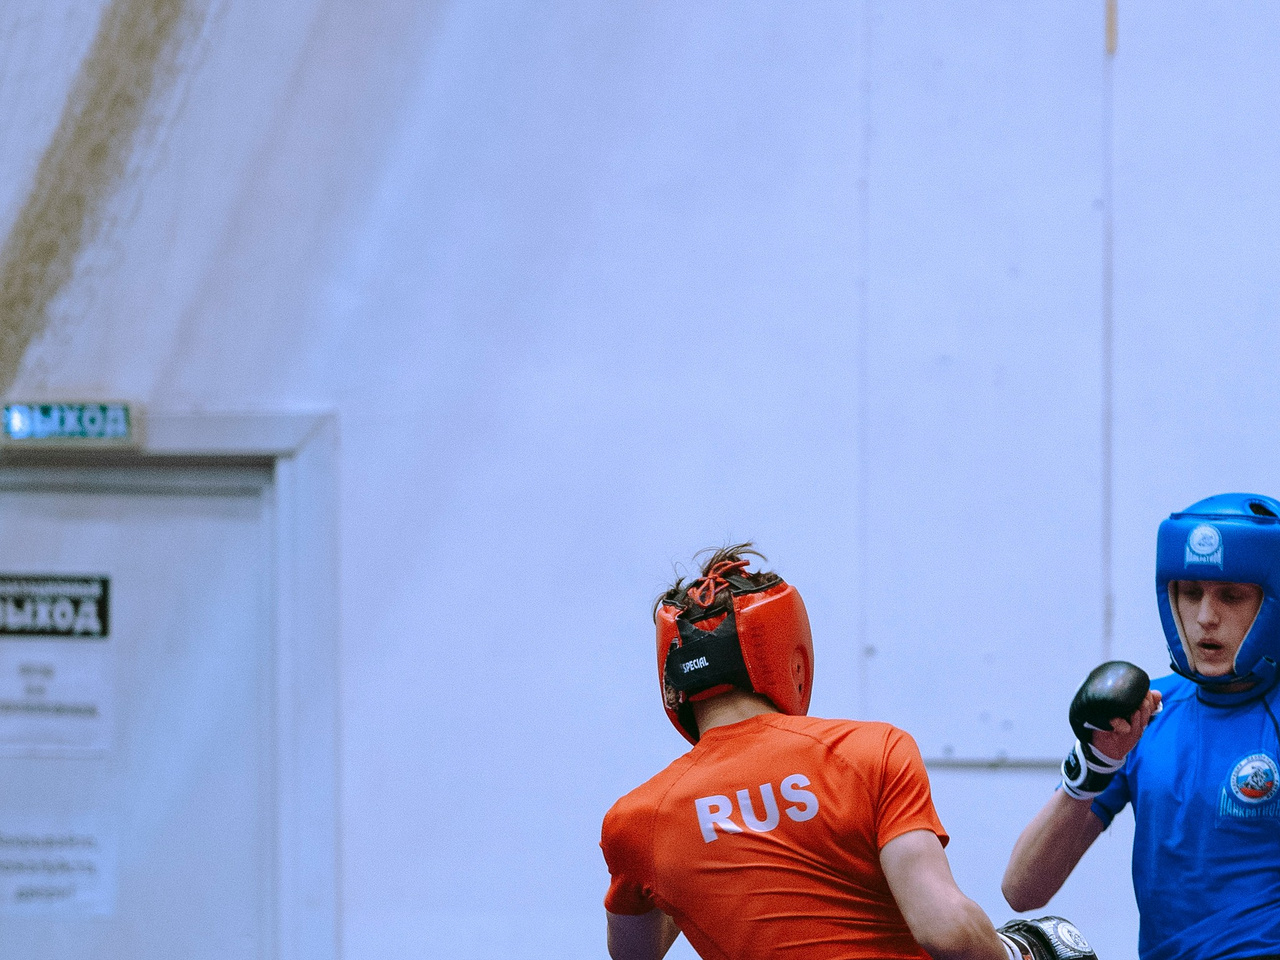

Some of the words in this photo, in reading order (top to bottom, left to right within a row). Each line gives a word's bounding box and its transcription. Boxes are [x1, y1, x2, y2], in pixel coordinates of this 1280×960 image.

[8, 404, 127, 438] ВЫХОД
[0, 598, 101, 636] ЫХОД
[681, 656, 709, 674] SPECIAL
[694, 773, 819, 844] RUS
